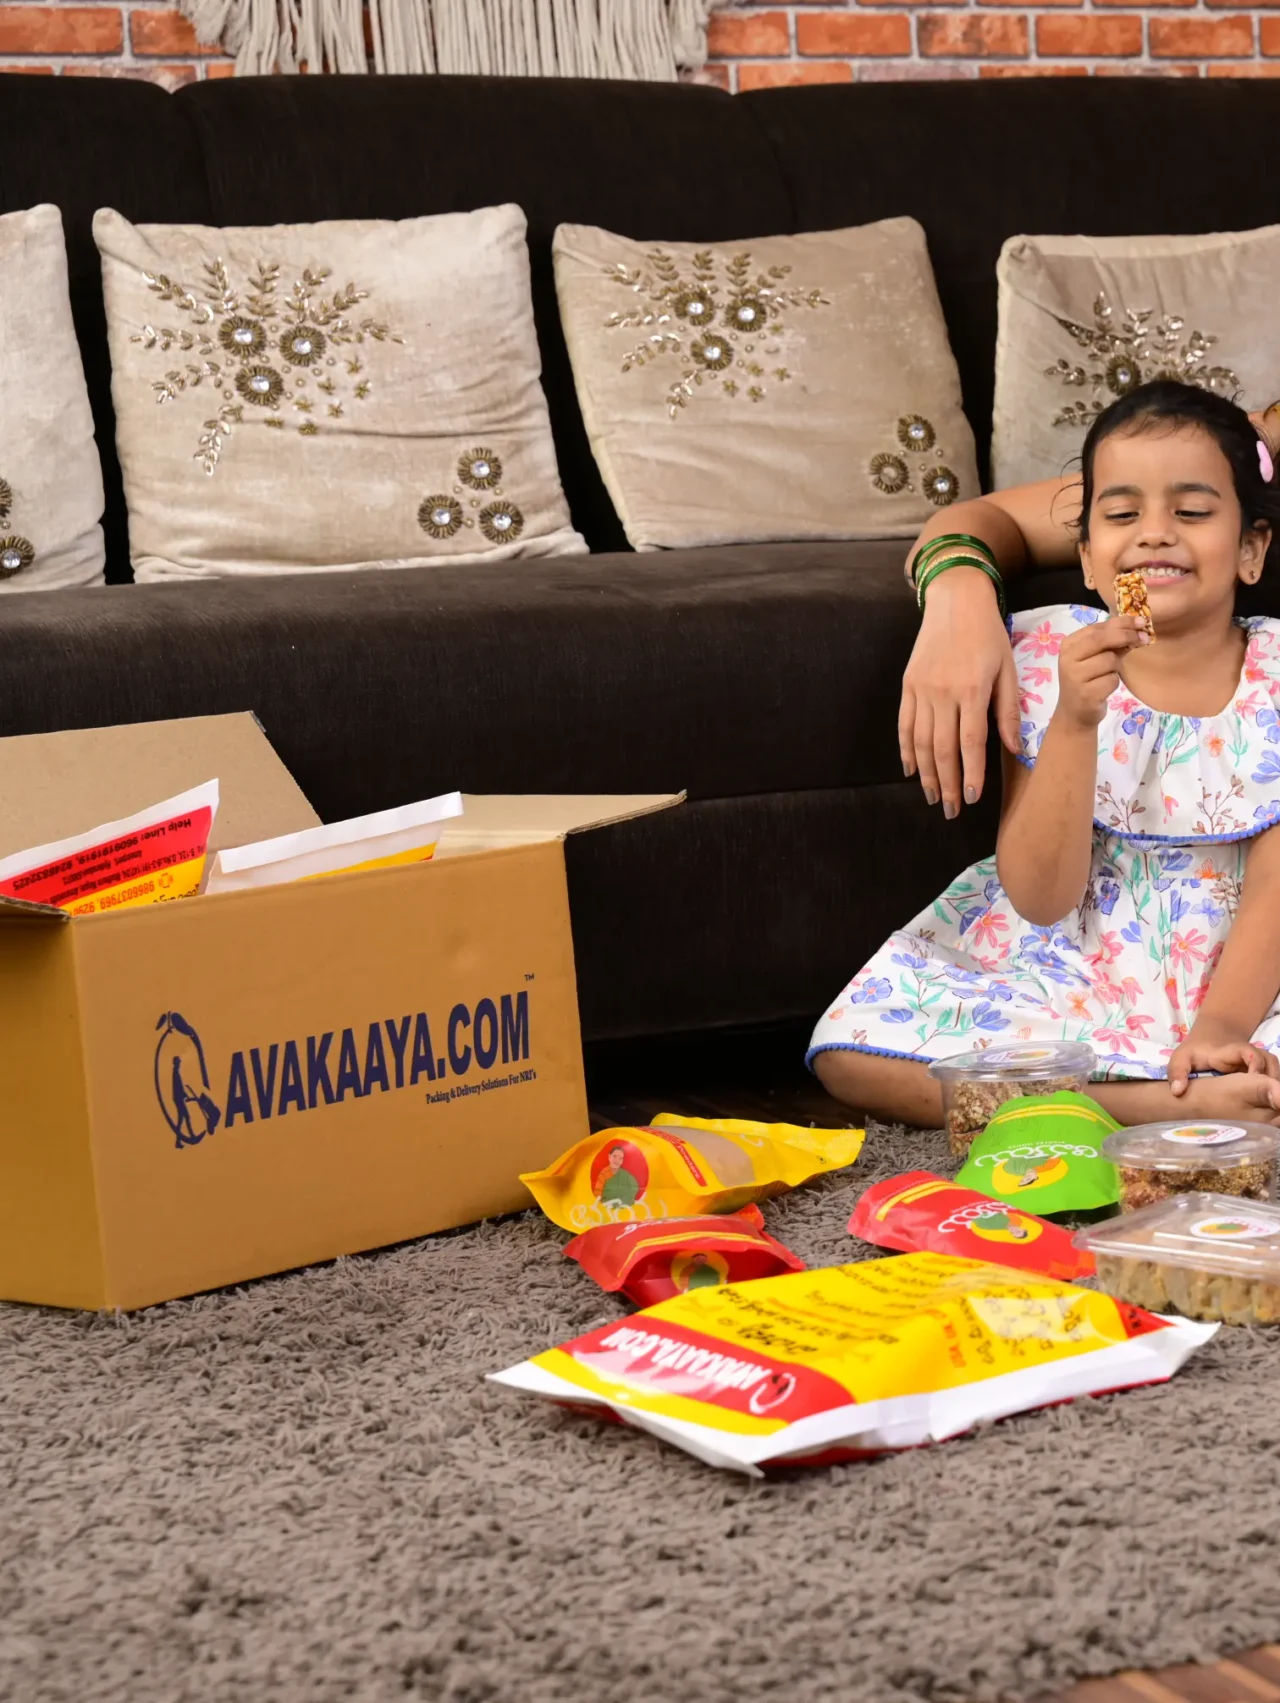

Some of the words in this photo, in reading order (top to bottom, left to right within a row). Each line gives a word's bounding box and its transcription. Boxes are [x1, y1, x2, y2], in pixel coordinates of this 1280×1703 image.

[141, 827, 166, 840] Line:
[168, 819, 192, 832] Help
[99, 881, 155, 910] 9866037969,
[225, 991, 530, 1128] AVAKAAYA.COM
[426, 1092, 450, 1105] Packing
[450, 1089, 456, 1099] &
[457, 1084, 481, 1098] Delivery
[482, 1078, 508, 1090] Solutions
[509, 1074, 519, 1085] For
